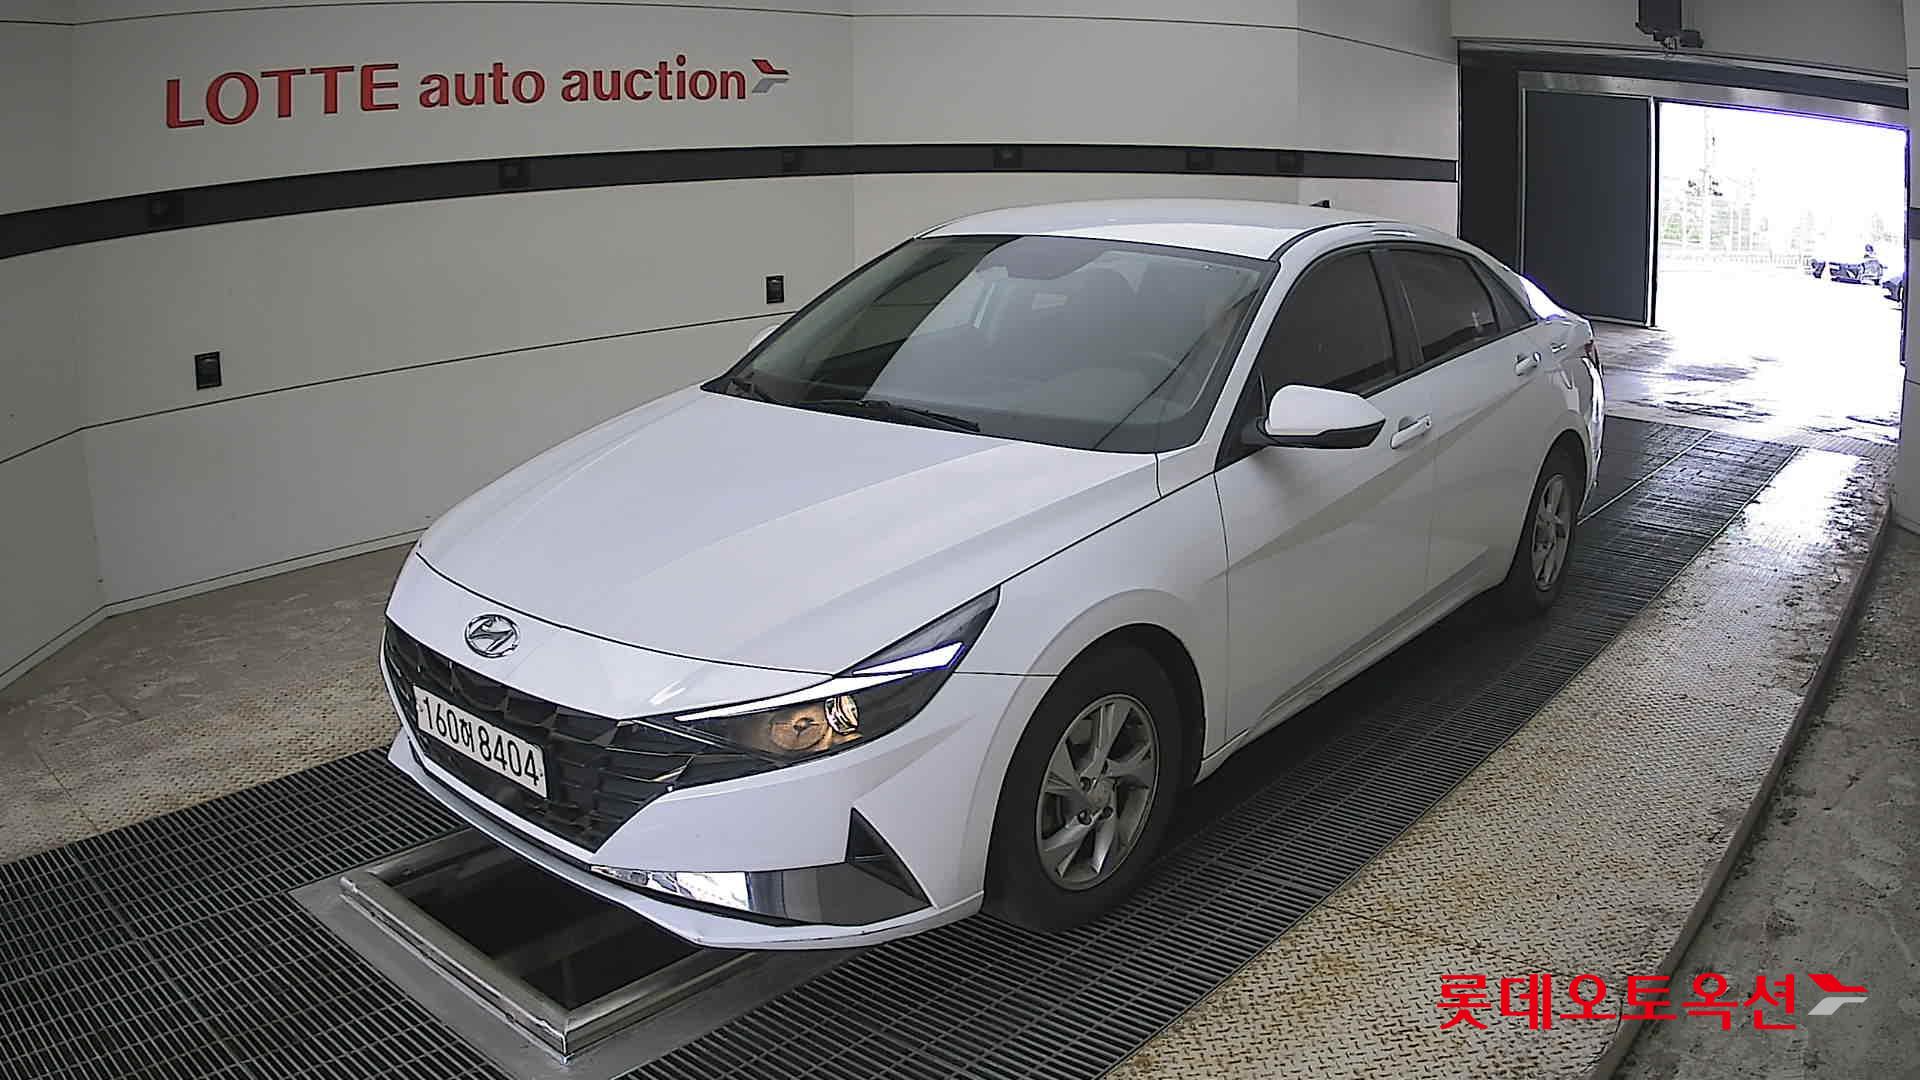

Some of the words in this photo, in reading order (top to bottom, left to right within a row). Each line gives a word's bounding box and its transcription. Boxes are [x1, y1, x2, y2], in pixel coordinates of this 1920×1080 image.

[164, 63, 400, 129] LOTTE
[419, 62, 546, 109] auto
[561, 54, 747, 103] auction
